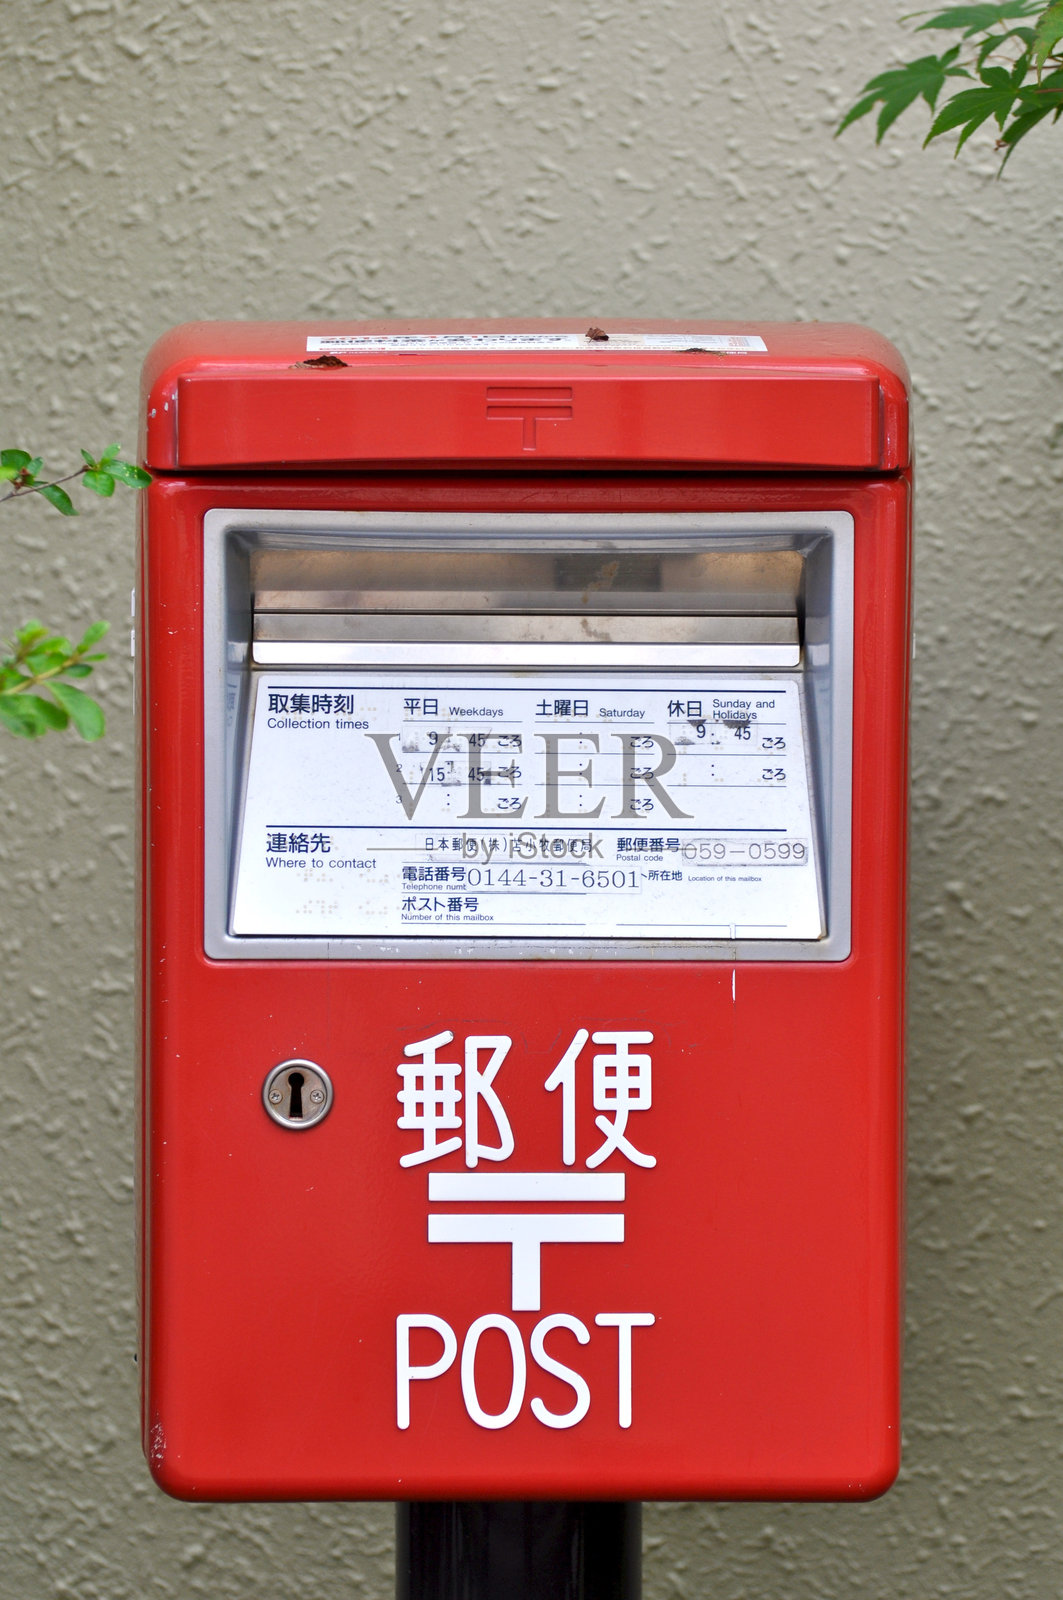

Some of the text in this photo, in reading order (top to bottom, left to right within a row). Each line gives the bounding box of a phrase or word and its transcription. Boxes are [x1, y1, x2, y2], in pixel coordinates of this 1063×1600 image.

[268, 693, 354, 715] 取集時刻
[403, 698, 438, 715] 平日
[535, 699, 589, 717] 土曜日
[667, 699, 703, 718] 休日
[712, 698, 776, 709] Sunday and
[449, 706, 504, 717] Weekdays
[599, 708, 646, 719] Saturday
[712, 710, 758, 721] Holidays
[267, 718, 369, 730] Collection times
[429, 731, 486, 747] 9 45
[696, 724, 751, 741] 9 45
[498, 734, 522, 748] ごろ
[630, 735, 654, 748] ごろ
[761, 736, 787, 750] ごろ
[429, 767, 485, 782] 15 45
[498, 766, 522, 779] ごろ
[630, 767, 654, 780] ごろ
[761, 768, 787, 781] ごろ
[497, 797, 522, 810] ごろ
[630, 798, 654, 811] ごろ
[266, 832, 331, 853] 連絡先
[617, 837, 681, 853] 郵便番号
[266, 857, 377, 869] Where to contact
[616, 853, 664, 862] Postal code
[402, 866, 466, 882] 電話番号
[467, 867, 640, 889] 0144-31-6501
[402, 883, 443, 891] Telephone
[402, 896, 479, 912] ポスト番号
[401, 913, 495, 922] Number of this mailbox
[396, 1028, 657, 1169] 郵便
[396, 1312, 656, 1430] POST
